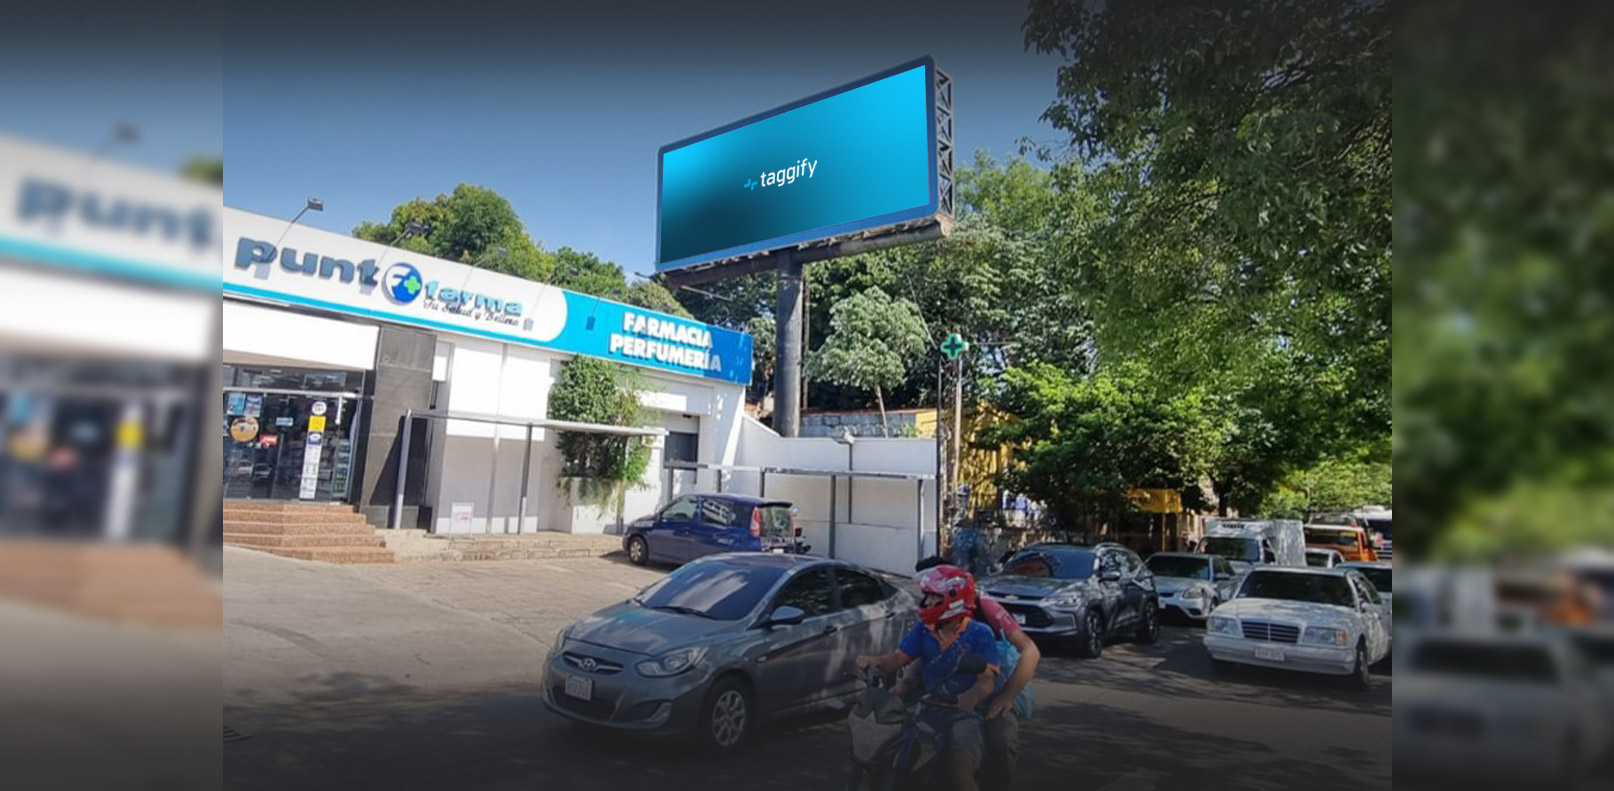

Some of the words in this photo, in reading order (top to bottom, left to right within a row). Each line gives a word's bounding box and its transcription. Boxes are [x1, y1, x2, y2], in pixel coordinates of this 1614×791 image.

[760, 158, 817, 187] taggify
[425, 281, 522, 317] farma
[442, 302, 473, 318] Salud
[474, 311, 482, 321] y
[623, 311, 712, 349] FARMACIA
[609, 333, 721, 371] PERFUMERÍA
